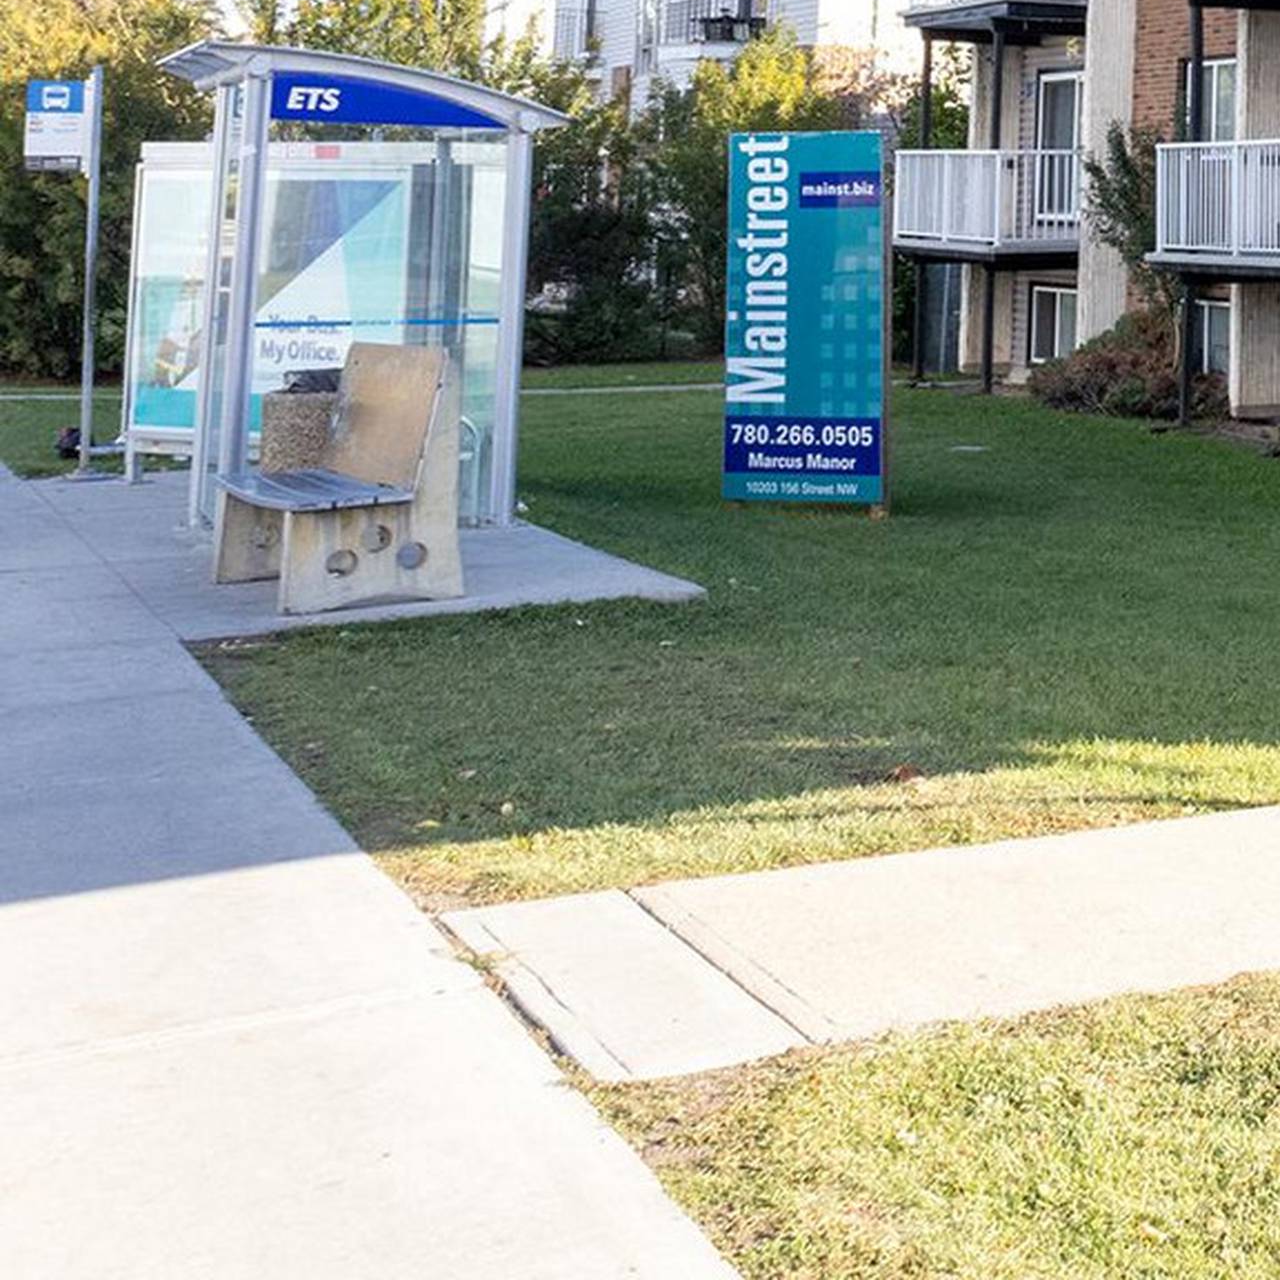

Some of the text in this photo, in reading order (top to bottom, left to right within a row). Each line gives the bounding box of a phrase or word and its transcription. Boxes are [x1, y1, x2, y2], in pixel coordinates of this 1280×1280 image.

[286, 86, 341, 112] ETS
[802, 181, 874, 197] mainst.biz
[726, 134, 790, 404] Mainstreet
[261, 339, 286, 365] My
[731, 424, 873, 447] 780.266.0505
[748, 452, 857, 471] Marcus Manor
[802, 482, 835, 496] Street
[837, 483, 859, 496] NW
